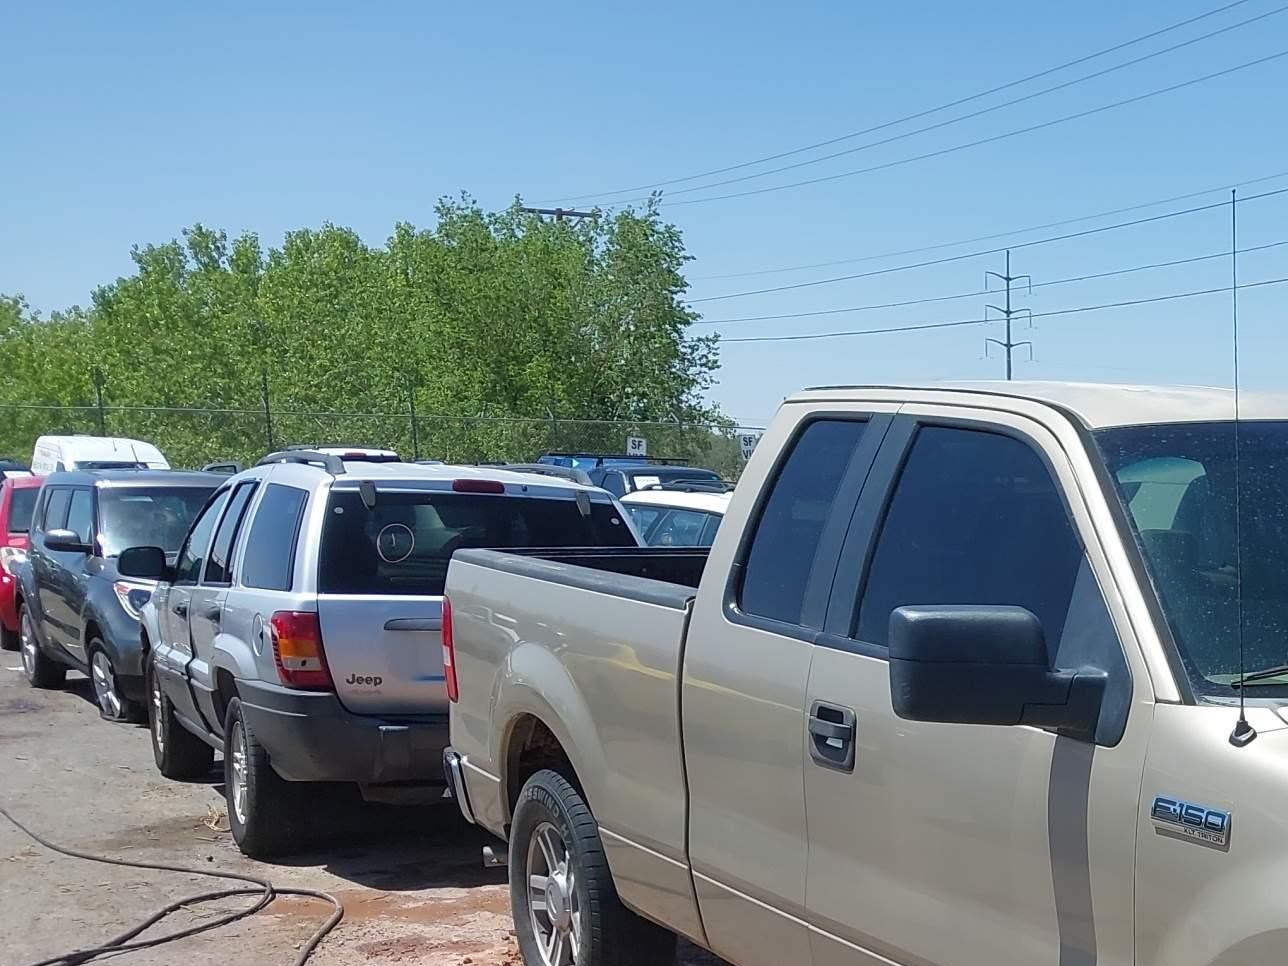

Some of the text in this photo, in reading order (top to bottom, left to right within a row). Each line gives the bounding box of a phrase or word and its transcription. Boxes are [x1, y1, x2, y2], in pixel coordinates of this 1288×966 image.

[631, 440, 643, 450] SF
[743, 436, 753, 447] SF
[345, 673, 383, 687] Jeep
[1153, 797, 1226, 832] F-150
[1196, 830, 1225, 844] TRITON
